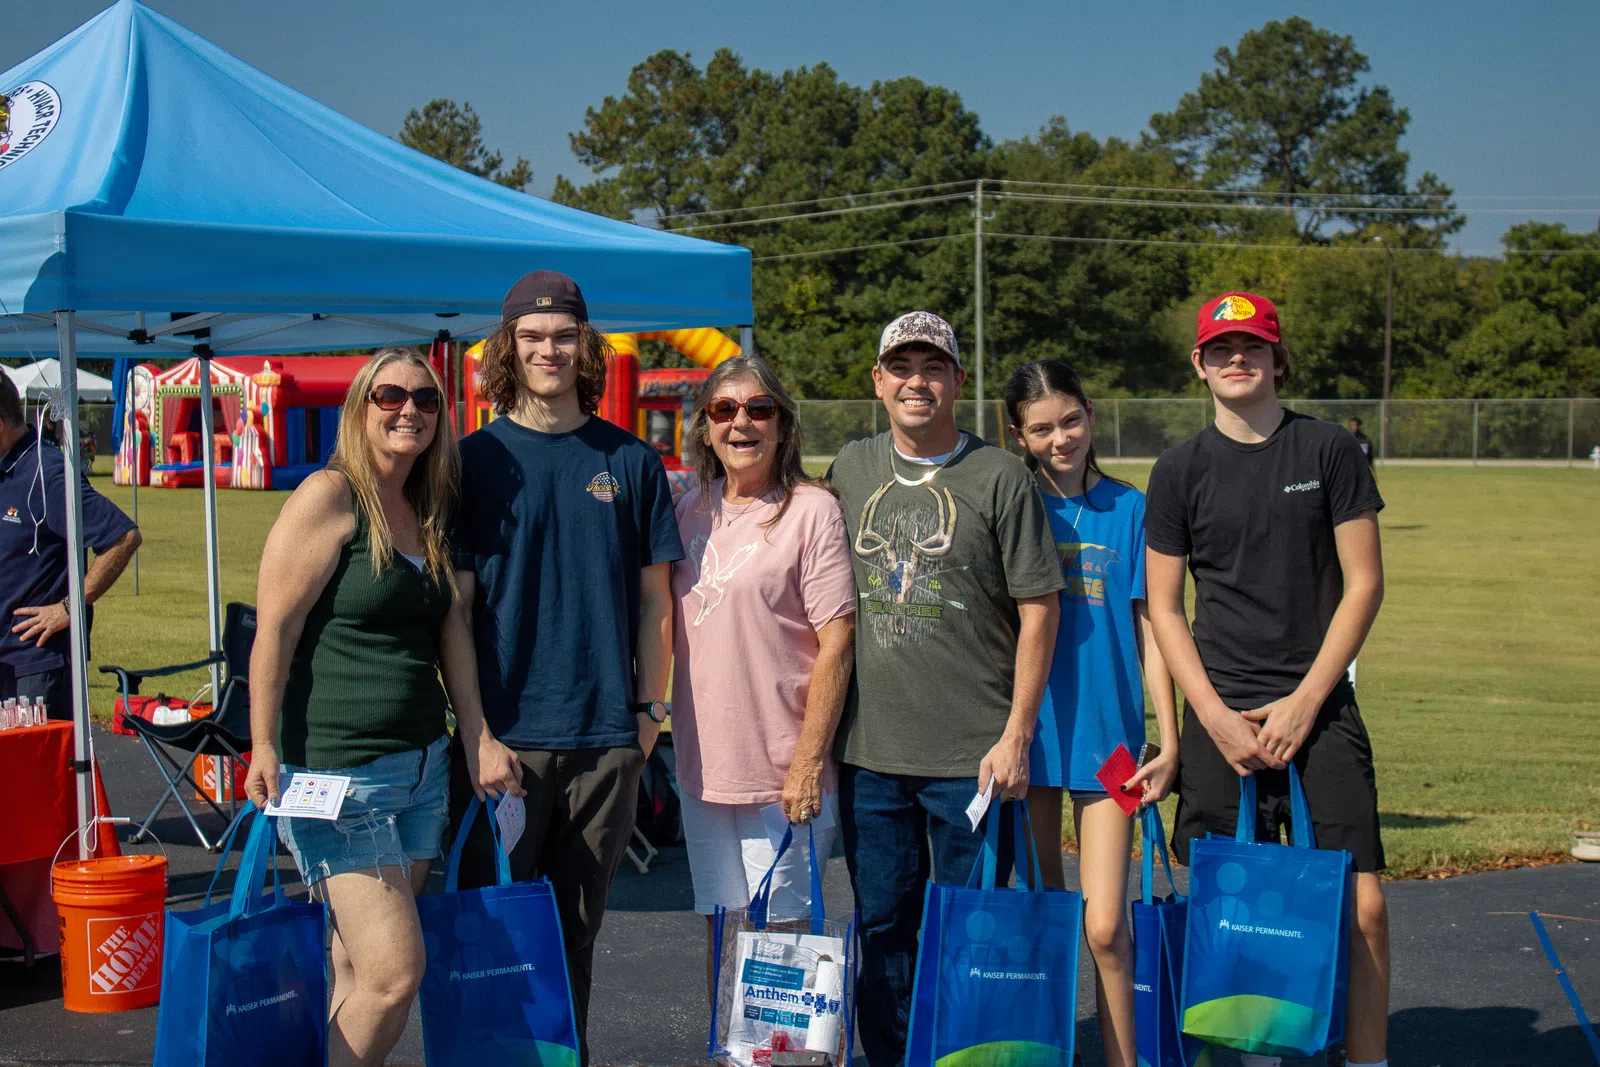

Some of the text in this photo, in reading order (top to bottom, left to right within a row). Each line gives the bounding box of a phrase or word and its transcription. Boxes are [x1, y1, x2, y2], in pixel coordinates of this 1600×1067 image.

[27, 89, 55, 121] HVACR
[1290, 480, 1320, 491] Columbia
[865, 601, 942, 617] REALTREE
[97, 925, 131, 957] THE
[1231, 924, 1302, 939] KAISER PERMANENTE
[91, 913, 159, 992] HOME
[121, 941, 159, 992] DEPOT
[462, 963, 533, 980] KAISER PERMANENTE
[1006, 972, 1047, 980] PERMANENTE
[238, 990, 296, 1013] KAISER PERMANENTE
[745, 985, 799, 1004] Anthem
